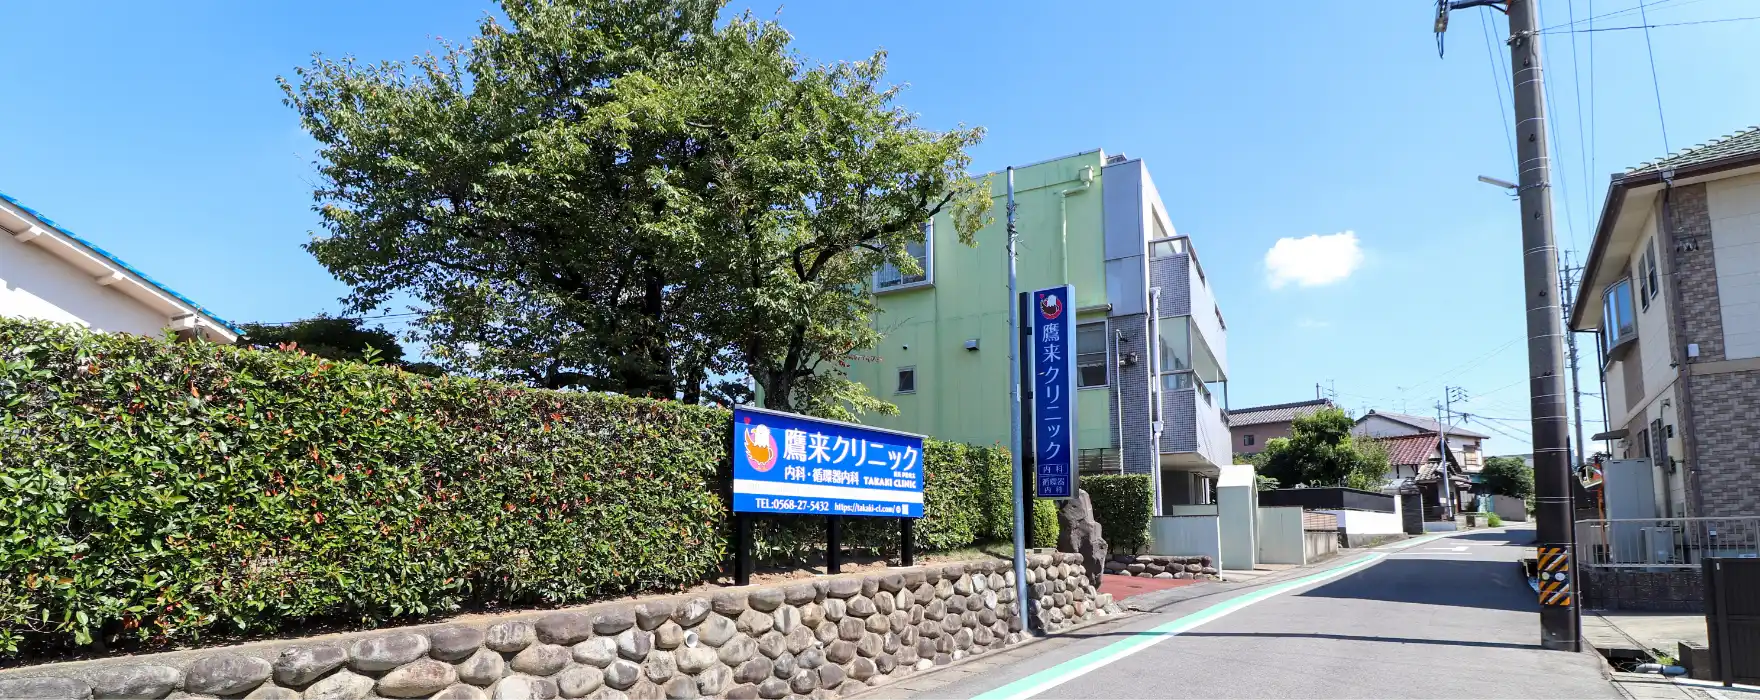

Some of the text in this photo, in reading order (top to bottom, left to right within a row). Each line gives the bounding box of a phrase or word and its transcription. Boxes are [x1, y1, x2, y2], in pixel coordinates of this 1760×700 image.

[1042, 323, 1062, 460] 鷹来クリニック
[783, 428, 918, 471] 鷹来クリニック
[784, 465, 859, 485] 内科・循環器内科
[1043, 465, 1063, 473] 内科
[863, 476, 916, 488] TAKAKI CLINIC
[755, 498, 829, 511] TEL:0568-27-5432
